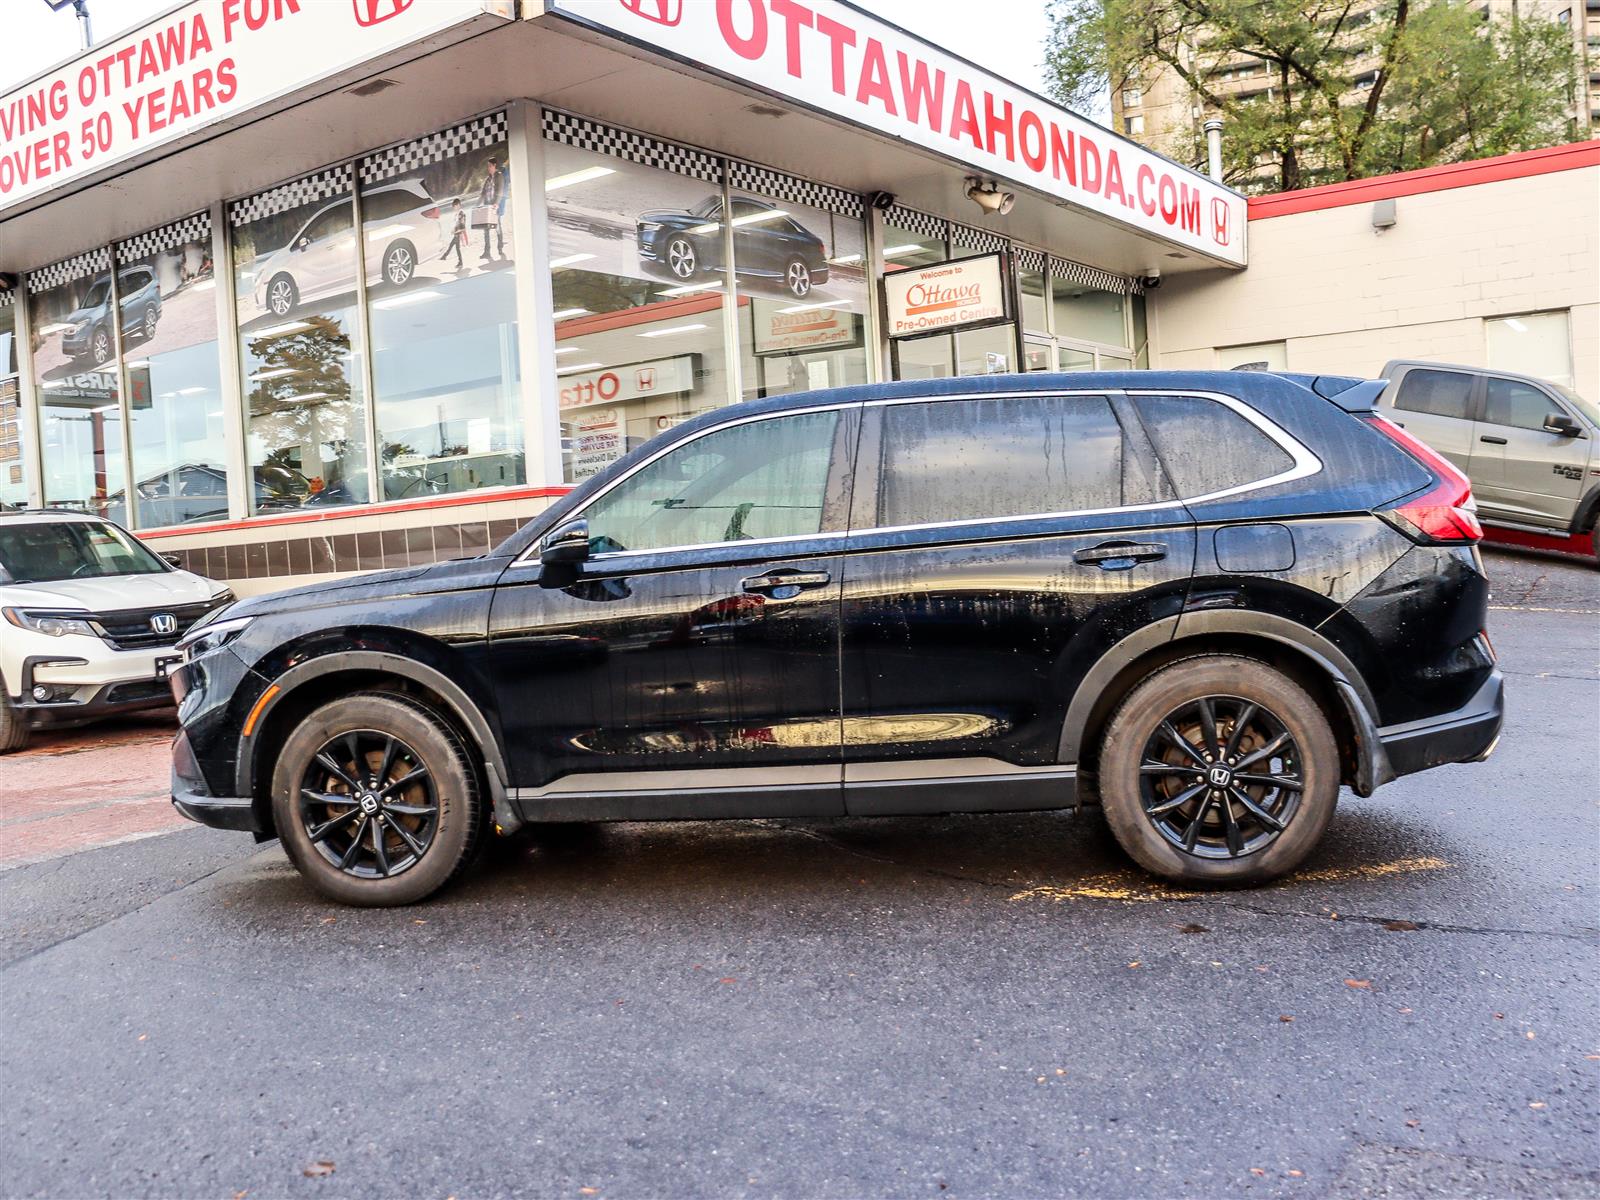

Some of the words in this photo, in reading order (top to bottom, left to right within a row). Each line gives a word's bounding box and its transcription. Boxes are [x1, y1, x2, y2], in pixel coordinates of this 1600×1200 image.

[0, 80, 68, 143] VING
[78, 13, 212, 107] OTTAWA
[0, 131, 72, 193] OVER
[81, 111, 113, 161] 50
[122, 57, 238, 140] YEARS
[716, 0, 1201, 236] OTTAWAHONDA.COM
[906, 283, 981, 307] Ottawa
[920, 269, 953, 280] Welcome
[955, 266, 963, 274] to
[896, 311, 957, 331] Pre-Owned
[960, 307, 998, 321] Centre
